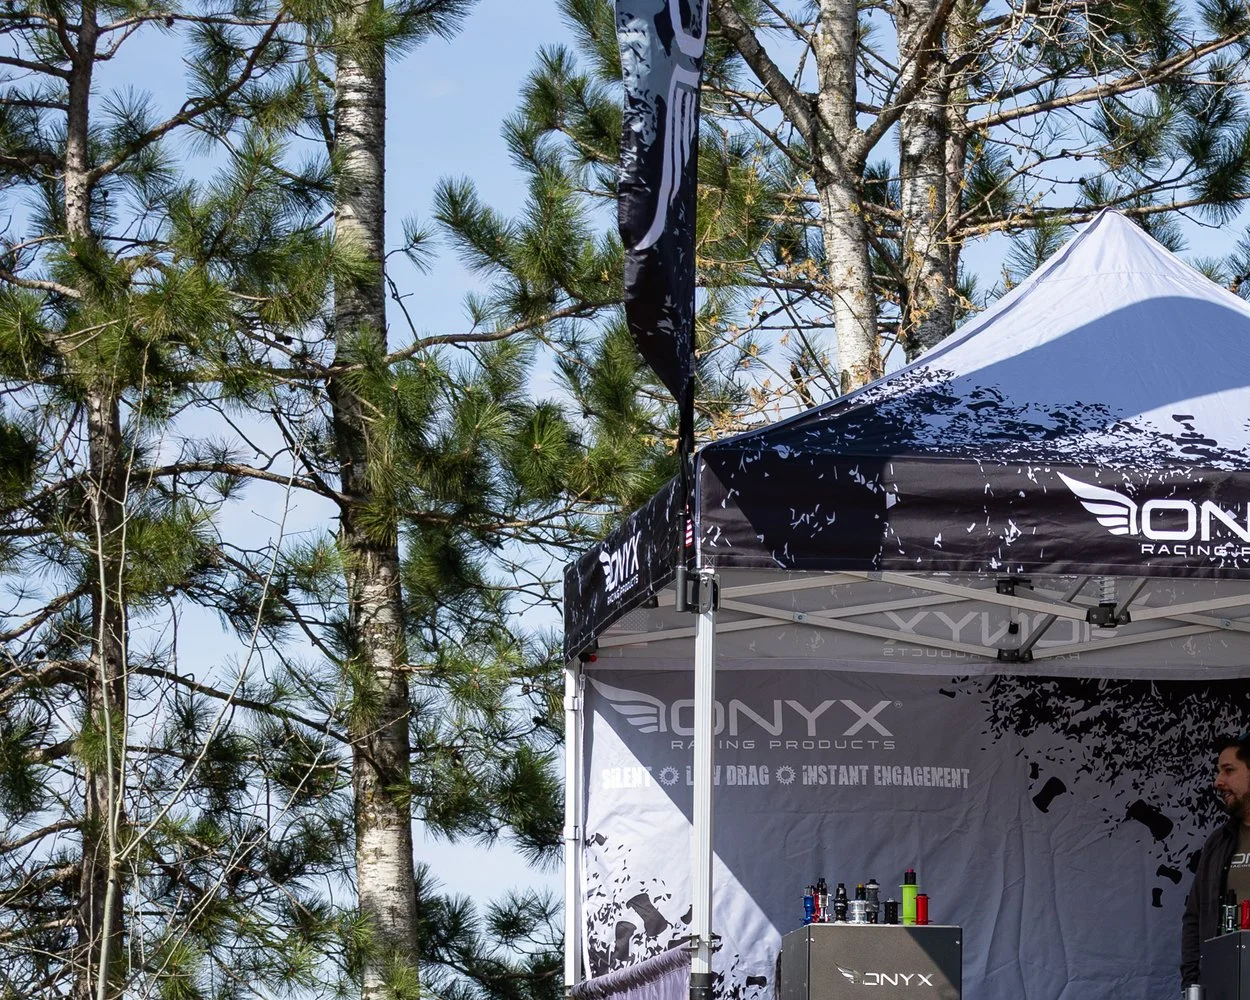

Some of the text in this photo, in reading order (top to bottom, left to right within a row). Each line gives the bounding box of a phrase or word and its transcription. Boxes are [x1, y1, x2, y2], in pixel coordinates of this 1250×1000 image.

[1141, 544, 1228, 556] RACING
[670, 699, 894, 737] ONYX
[671, 740, 896, 750] RAING PRODUCTS
[726, 765, 770, 786] DRAG
[802, 765, 869, 786] INSTANT
[873, 765, 970, 789] ENGAGEMENT
[863, 973, 934, 987] ONYX
